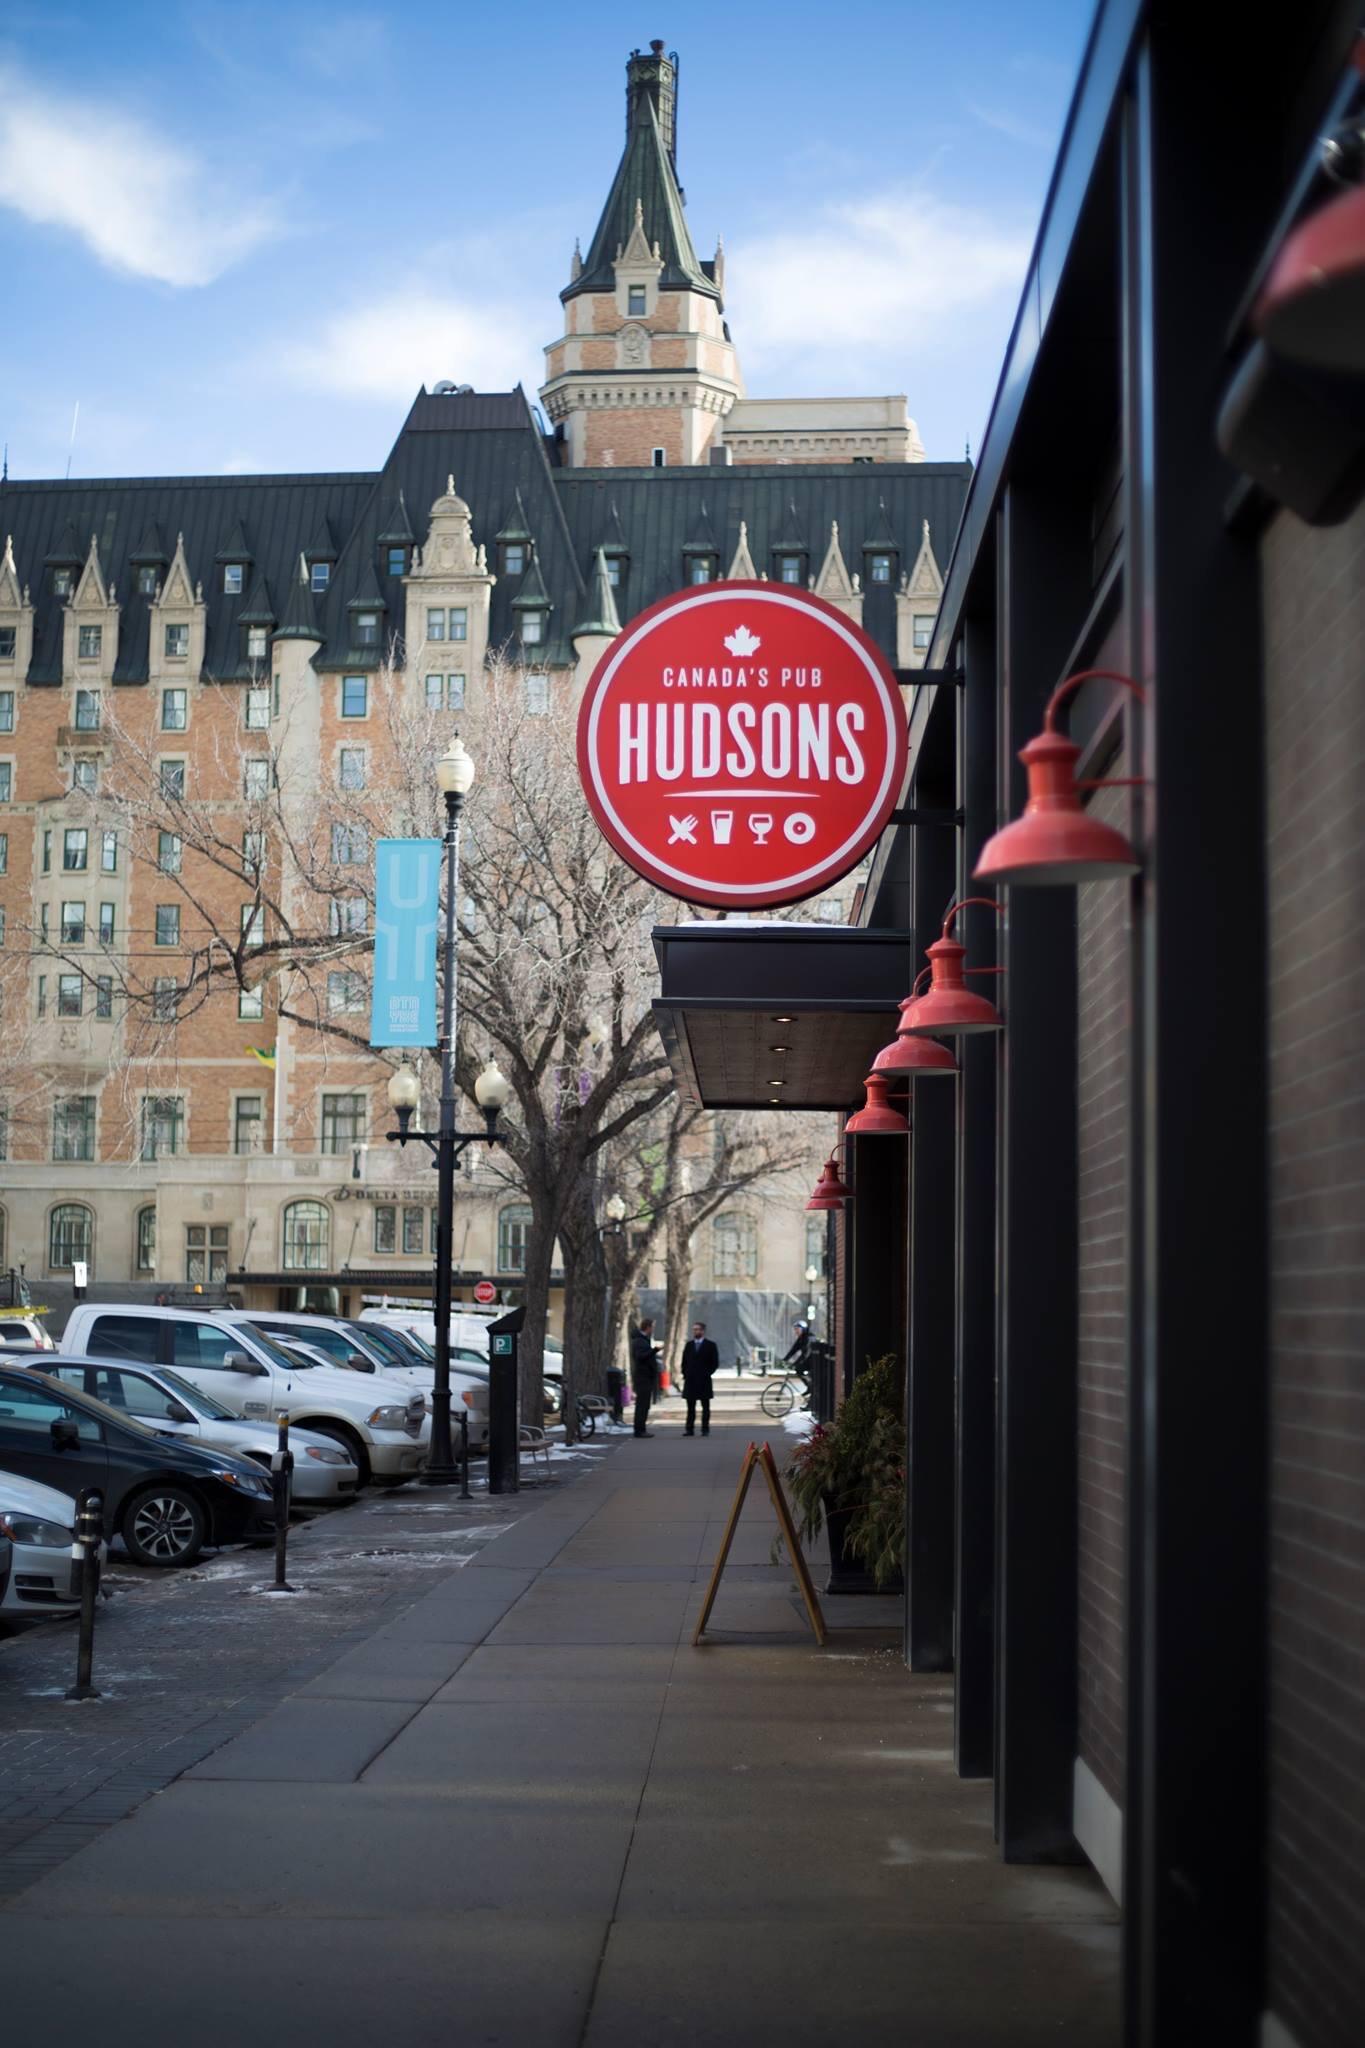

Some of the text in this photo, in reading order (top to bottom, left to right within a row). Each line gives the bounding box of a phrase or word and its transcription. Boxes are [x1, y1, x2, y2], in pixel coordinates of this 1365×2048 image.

[663, 667, 822, 688] CANADA'S PUB
[618, 702, 865, 785] HUDSONS
[355, 1190, 398, 1200] DELTA
[476, 1287, 494, 1297] STOP
[495, 1338, 506, 1352] P
